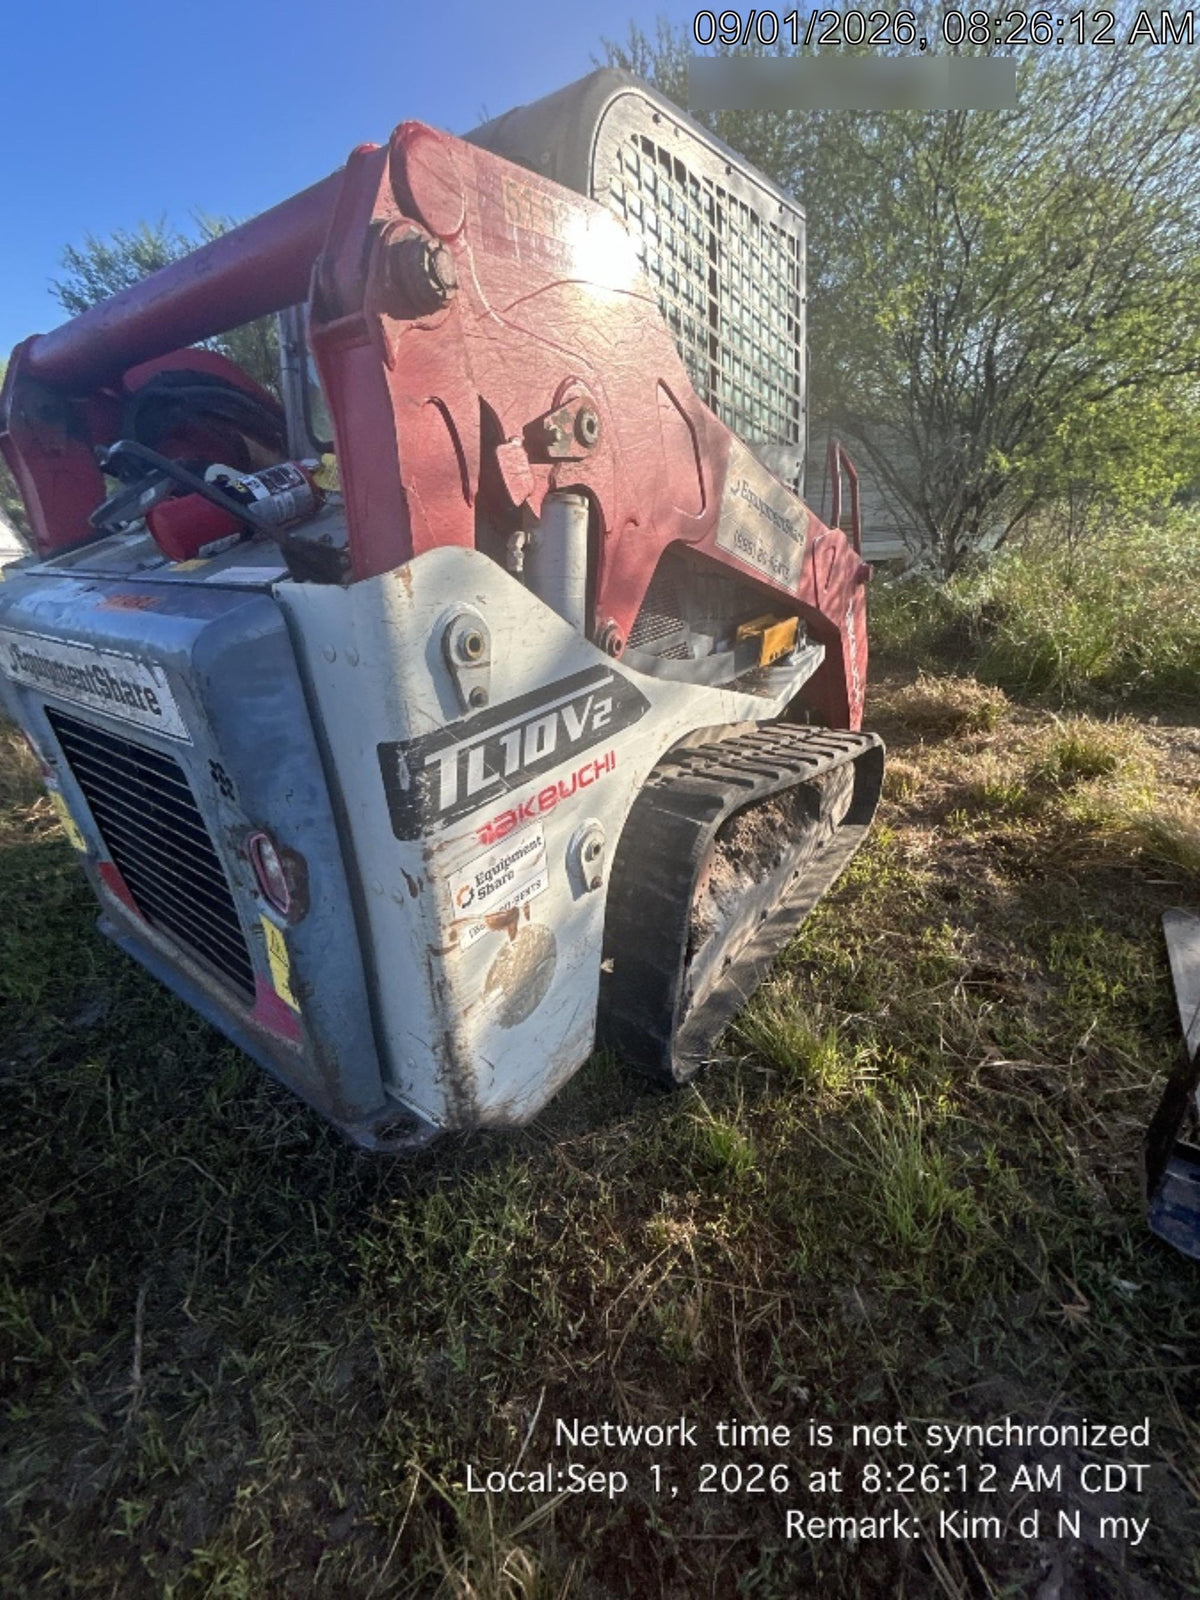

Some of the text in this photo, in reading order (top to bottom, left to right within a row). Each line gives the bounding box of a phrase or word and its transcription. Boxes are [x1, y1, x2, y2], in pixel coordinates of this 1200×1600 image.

[424, 675, 614, 812] TL10V2
[474, 836, 542, 888] Equipment
[477, 869, 515, 900] Share
